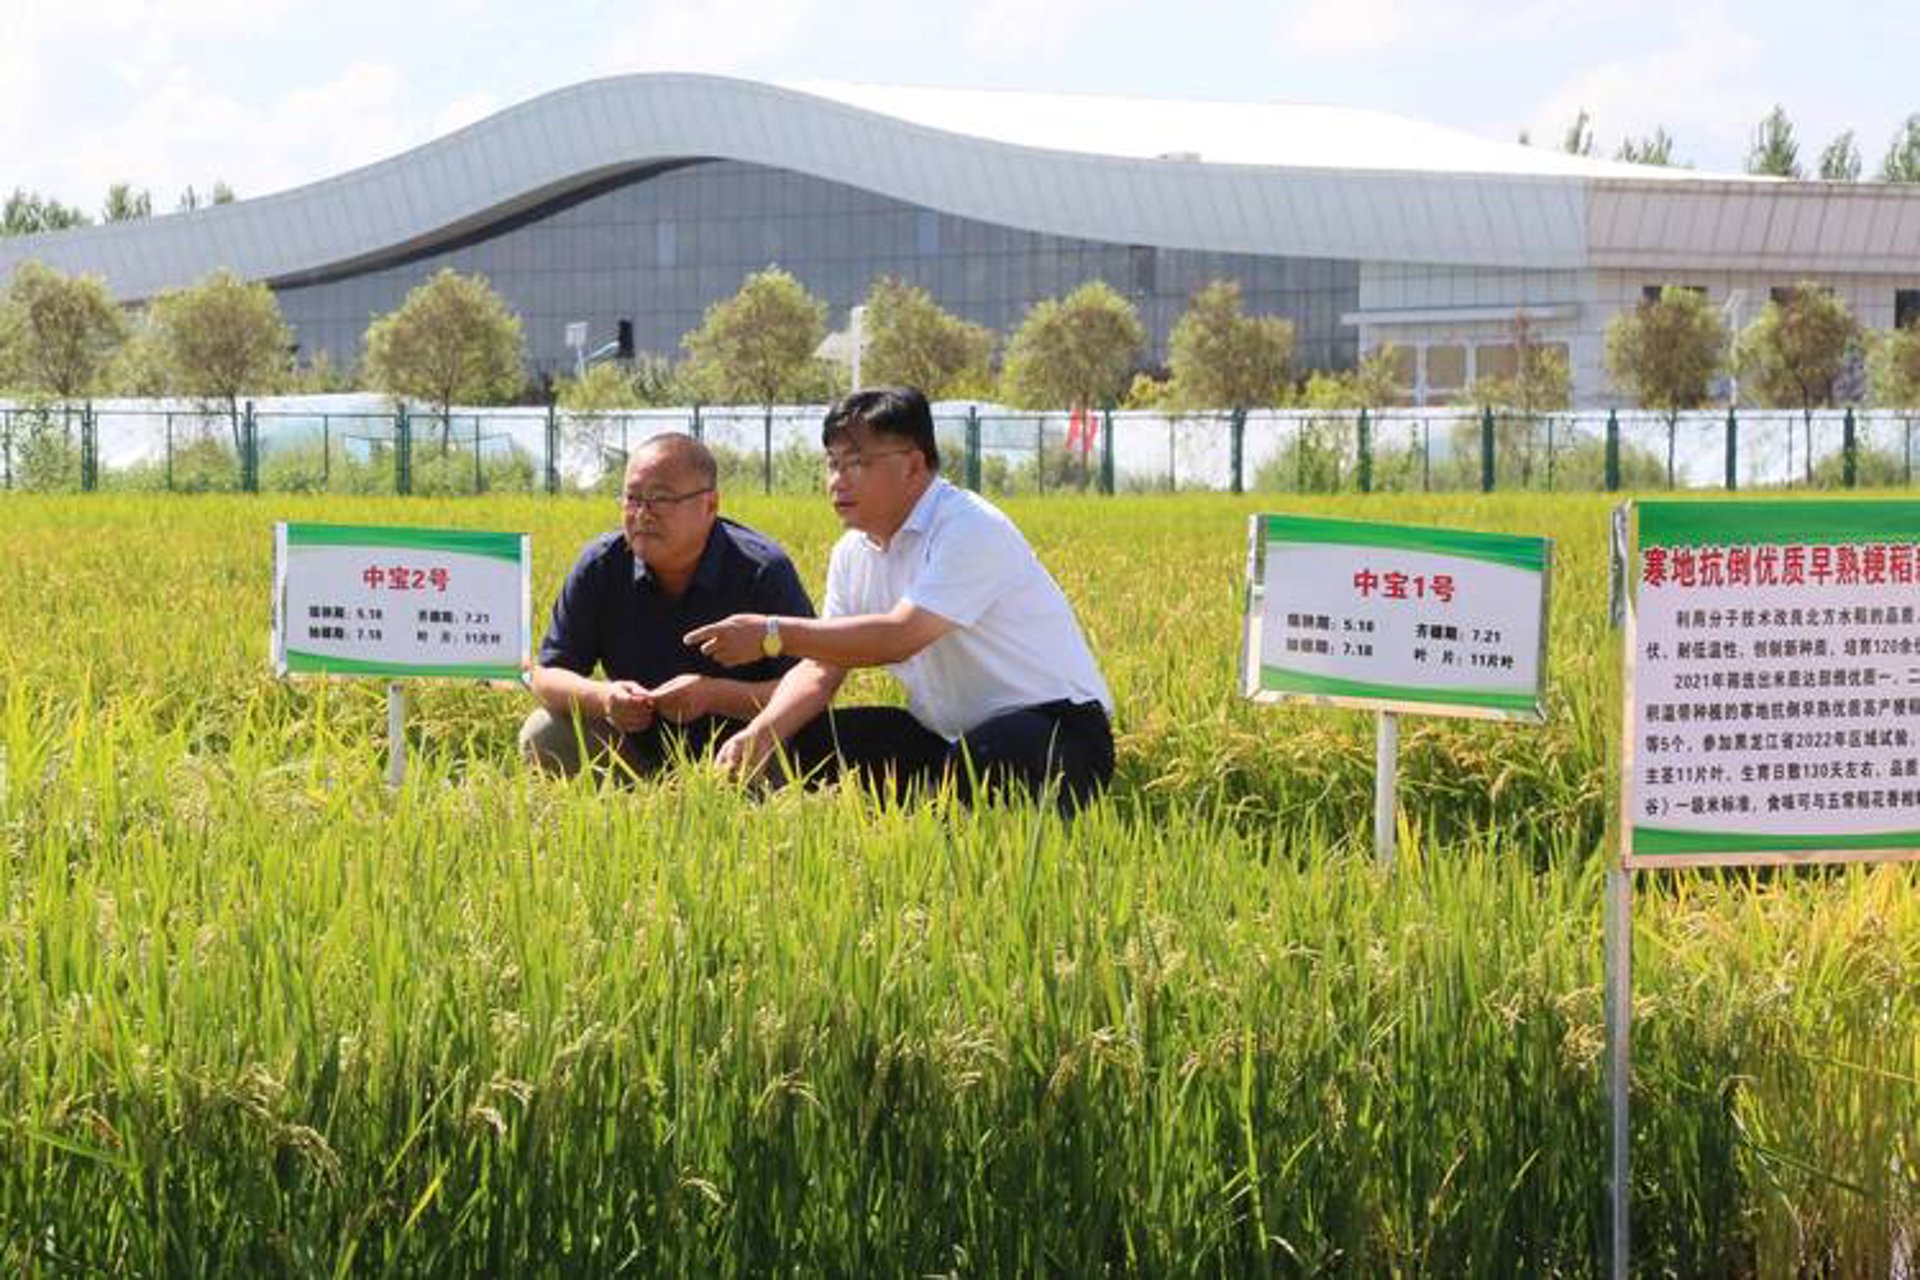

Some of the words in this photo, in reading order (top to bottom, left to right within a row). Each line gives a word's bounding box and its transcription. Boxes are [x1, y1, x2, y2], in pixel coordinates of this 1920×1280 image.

[363, 565, 450, 591] 中宝2号
[1643, 545, 1920, 586] 寒地抗倒优质早熟粳稻
[1354, 569, 1454, 602] 中宝1号
